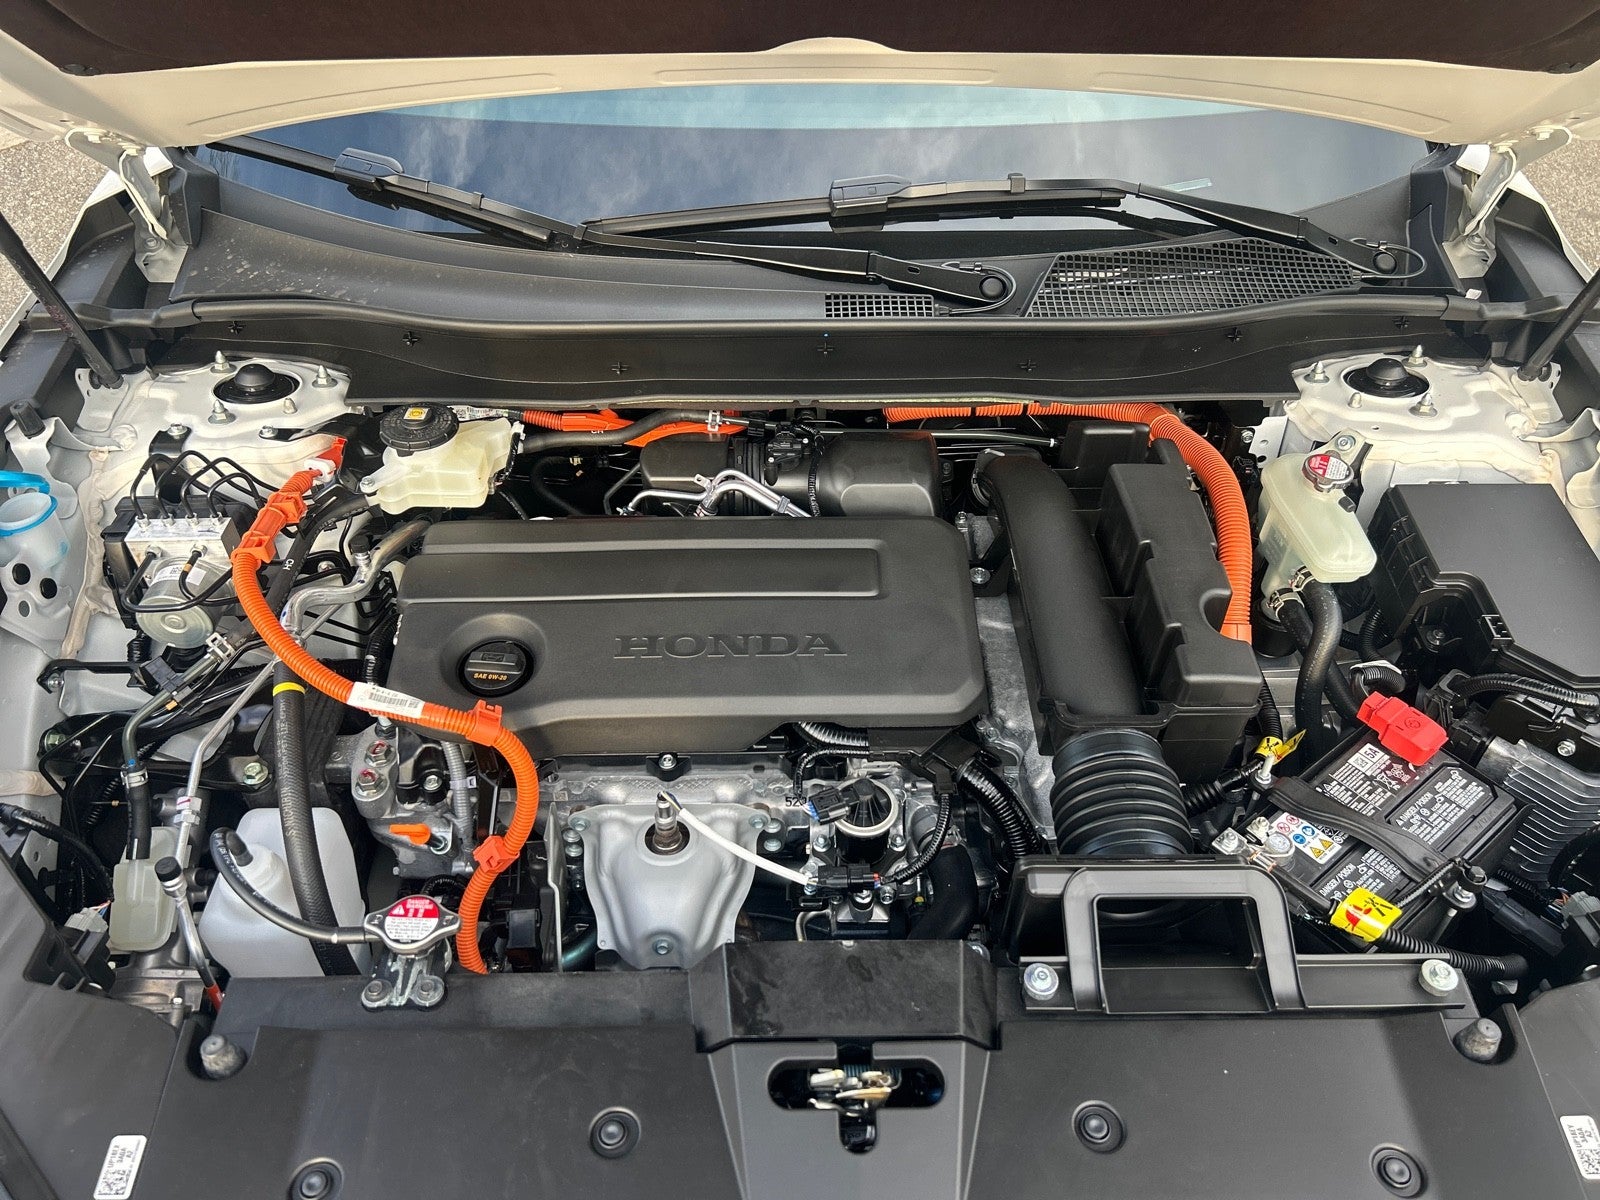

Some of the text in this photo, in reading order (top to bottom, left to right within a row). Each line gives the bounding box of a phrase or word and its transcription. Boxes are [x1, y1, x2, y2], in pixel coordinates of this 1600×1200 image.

[614, 632, 848, 660] HONDA
[488, 673, 508, 681] 0W-20
[1364, 747, 1380, 759] 5A
